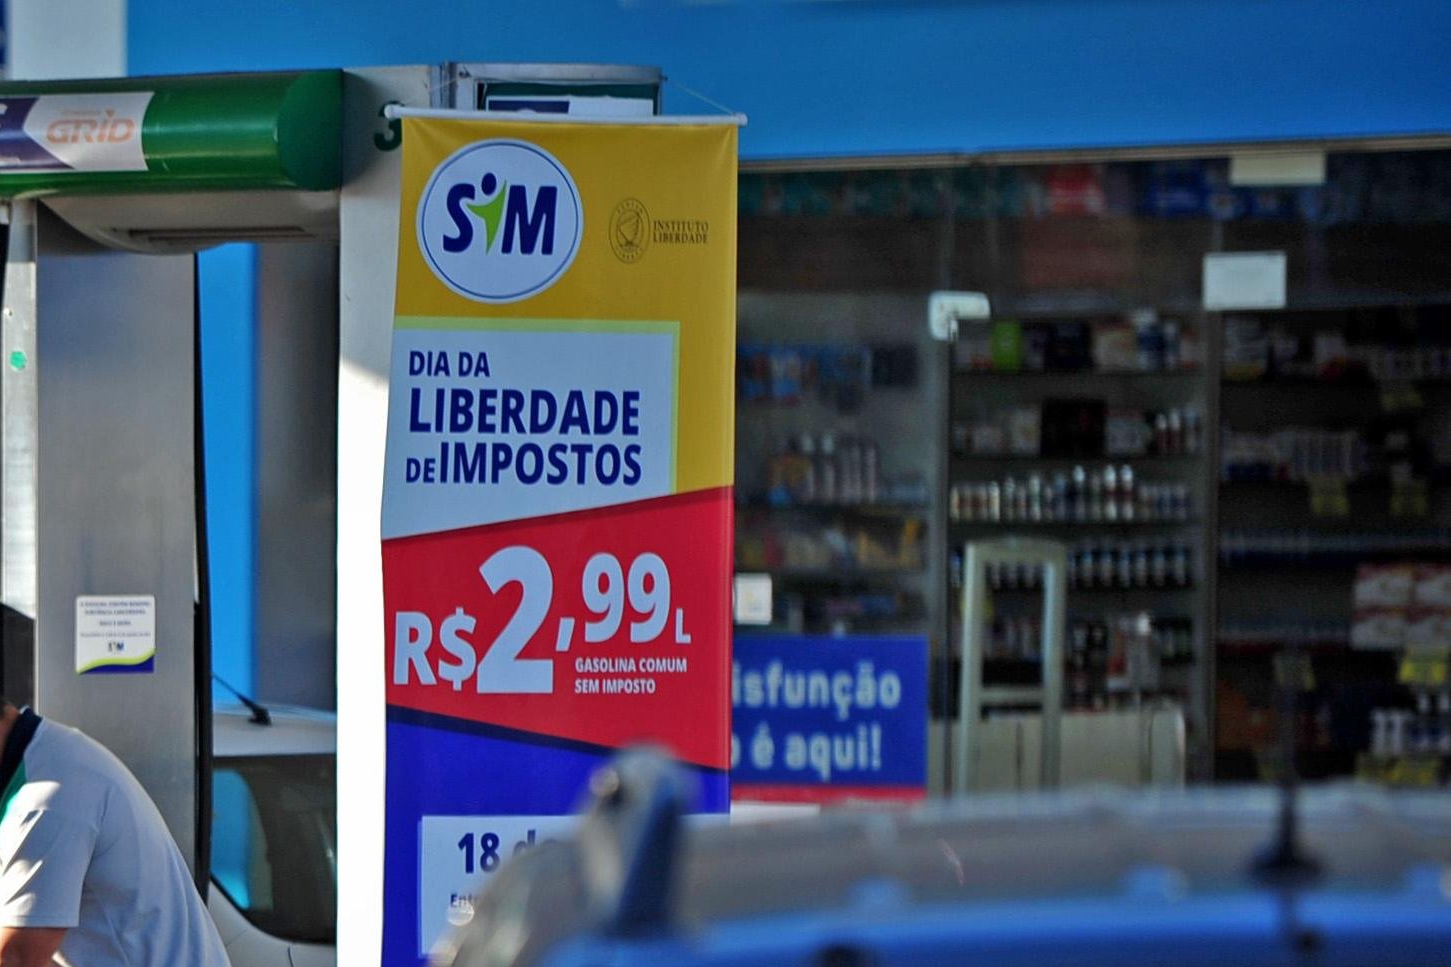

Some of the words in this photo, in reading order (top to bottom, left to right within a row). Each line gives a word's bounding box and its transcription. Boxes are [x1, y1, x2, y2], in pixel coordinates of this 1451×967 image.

[653, 220, 709, 232] INSTITUTO
[653, 232, 708, 244] LIBERDADE
[409, 351, 450, 377] DIA
[458, 352, 491, 378] DA
[409, 387, 641, 436] LIBERDADE
[405, 457, 436, 484] DE
[439, 441, 642, 486] IMPOSTOS
[574, 657, 637, 674] GASOLINA
[639, 657, 688, 674] COMUM
[574, 678, 600, 694] SEM
[602, 678, 657, 695] IMPOSTO
[784, 721, 882, 783] aqui!
[457, 832, 500, 874] 18
